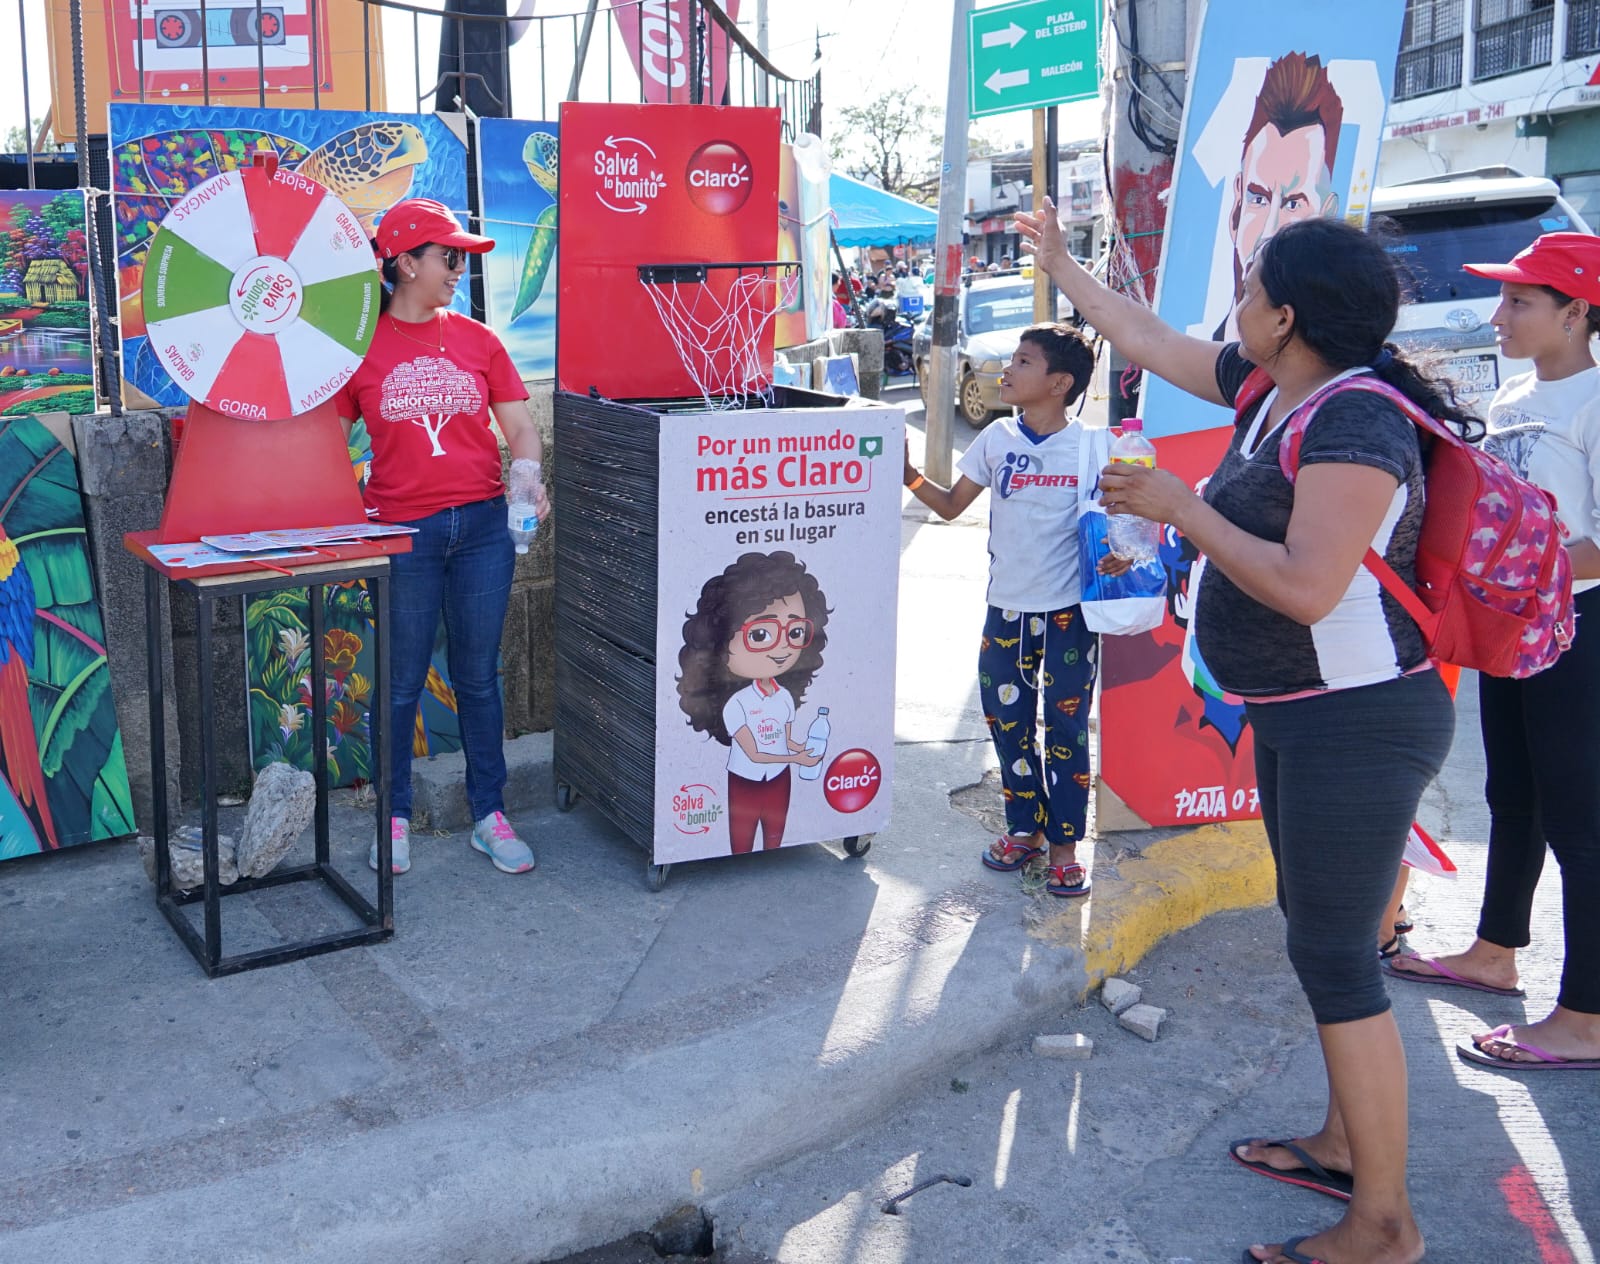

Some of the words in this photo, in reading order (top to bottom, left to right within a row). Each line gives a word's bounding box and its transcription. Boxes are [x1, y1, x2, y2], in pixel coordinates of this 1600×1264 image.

[1035, 27, 1052, 39] DEL
[1053, 19, 1087, 36] ESTERO
[1046, 11, 1075, 26] PLAZA
[1041, 60, 1083, 78] MALECÓN
[594, 150, 638, 176] Salvá
[273, 171, 315, 195] Pelota
[604, 176, 614, 189] lo
[615, 176, 658, 199] bonito
[689, 168, 742, 188] Claro
[174, 175, 231, 221] MANGAS
[336, 213, 363, 248] GRACIAS
[264, 274, 274, 283] lo
[241, 278, 270, 313] Bonito
[262, 273, 293, 311] Salvá
[165, 344, 195, 381] GRACIAS
[300, 366, 354, 410] MANGAS
[219, 399, 267, 420] GORRA
[387, 393, 453, 411] Reforesta
[697, 436, 737, 456] Por
[742, 437, 771, 454] un
[777, 429, 855, 453] mundo
[696, 456, 768, 492] más
[777, 454, 863, 488] Claro
[1009, 473, 1079, 490] SPORTS
[705, 503, 778, 524] encestá
[784, 502, 799, 520] la
[805, 501, 865, 519] basura
[735, 530, 759, 545] en
[764, 528, 785, 543] su
[790, 523, 837, 544] lugar
[827, 773, 871, 792] Claro
[672, 793, 704, 812] Salvá
[1174, 785, 1227, 818] PLATA
[679, 812, 686, 821] lo
[687, 810, 717, 826] bonito
